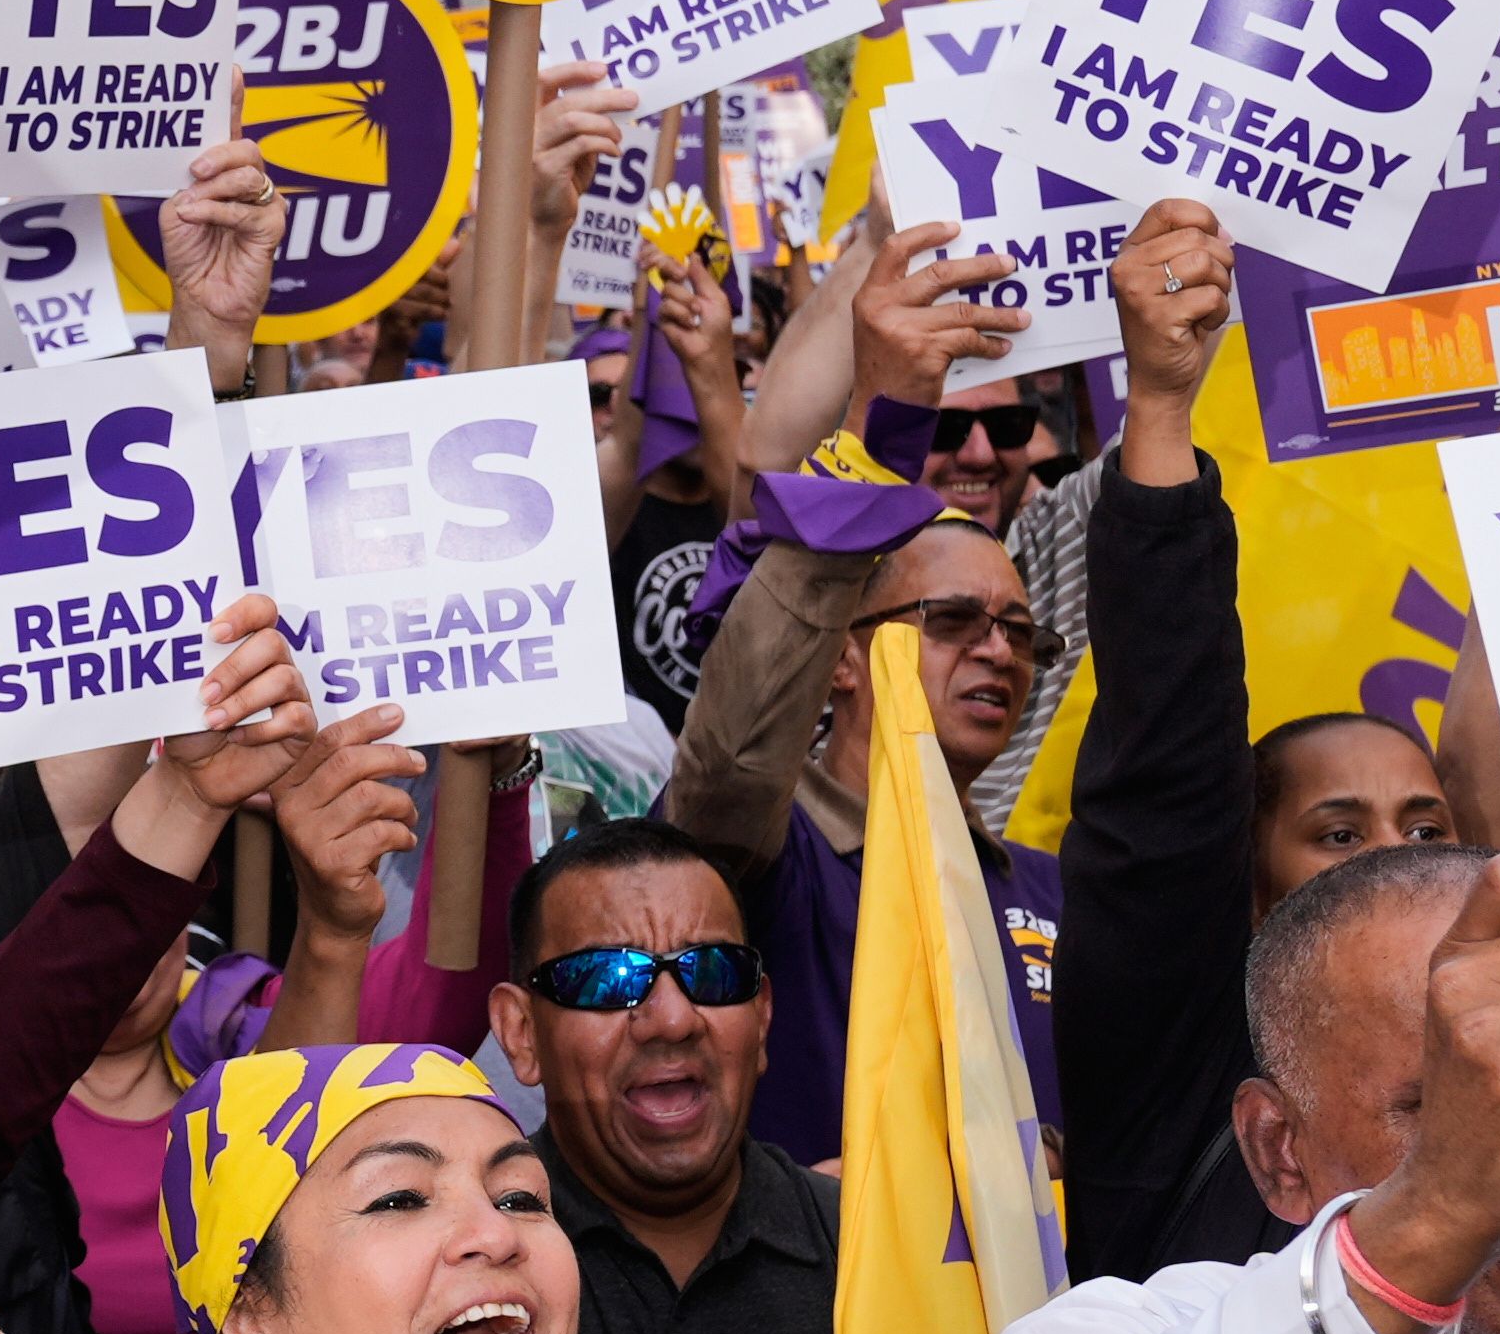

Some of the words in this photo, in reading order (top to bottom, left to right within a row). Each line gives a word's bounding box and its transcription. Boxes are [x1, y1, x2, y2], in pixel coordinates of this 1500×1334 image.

[603, 5, 668, 56] AM
[17, 67, 81, 105] AM
[97, 62, 220, 103] READY
[1041, 24, 1066, 66] I
[1073, 41, 1177, 109] AM
[1187, 82, 1411, 190] READY
[5, 110, 60, 153] TO
[70, 108, 205, 149] STRIKE
[1053, 79, 1130, 142] TO
[1142, 120, 1364, 230] STRIKE
[570, 231, 633, 259] STRIKE
[16, 575, 219, 652] READY
[346, 580, 576, 649] READY
[321, 635, 558, 704] STRIKE
